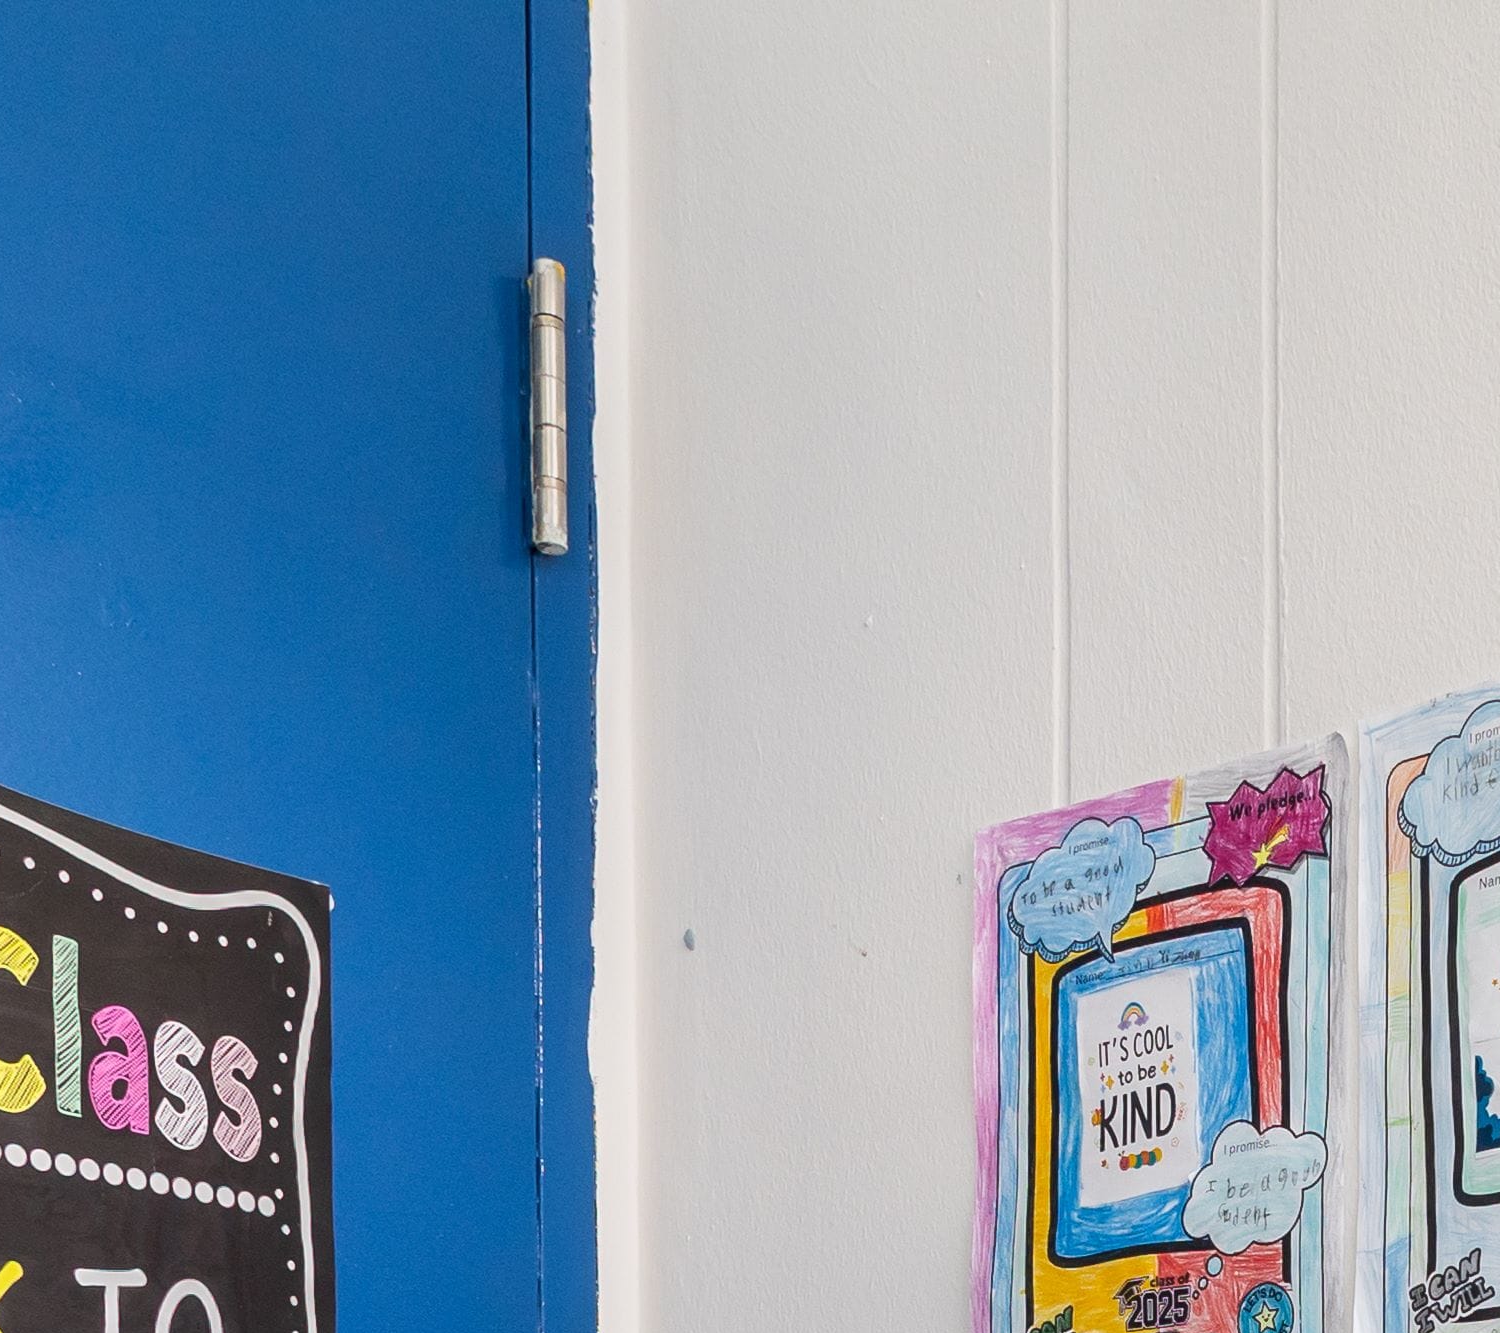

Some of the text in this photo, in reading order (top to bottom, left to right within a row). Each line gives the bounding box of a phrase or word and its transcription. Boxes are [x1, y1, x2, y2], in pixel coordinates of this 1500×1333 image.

[1098, 1024, 1174, 1068] IT'S COOL
[1118, 1064, 1156, 1084] to be
[1100, 1083, 1176, 1149] KIND
